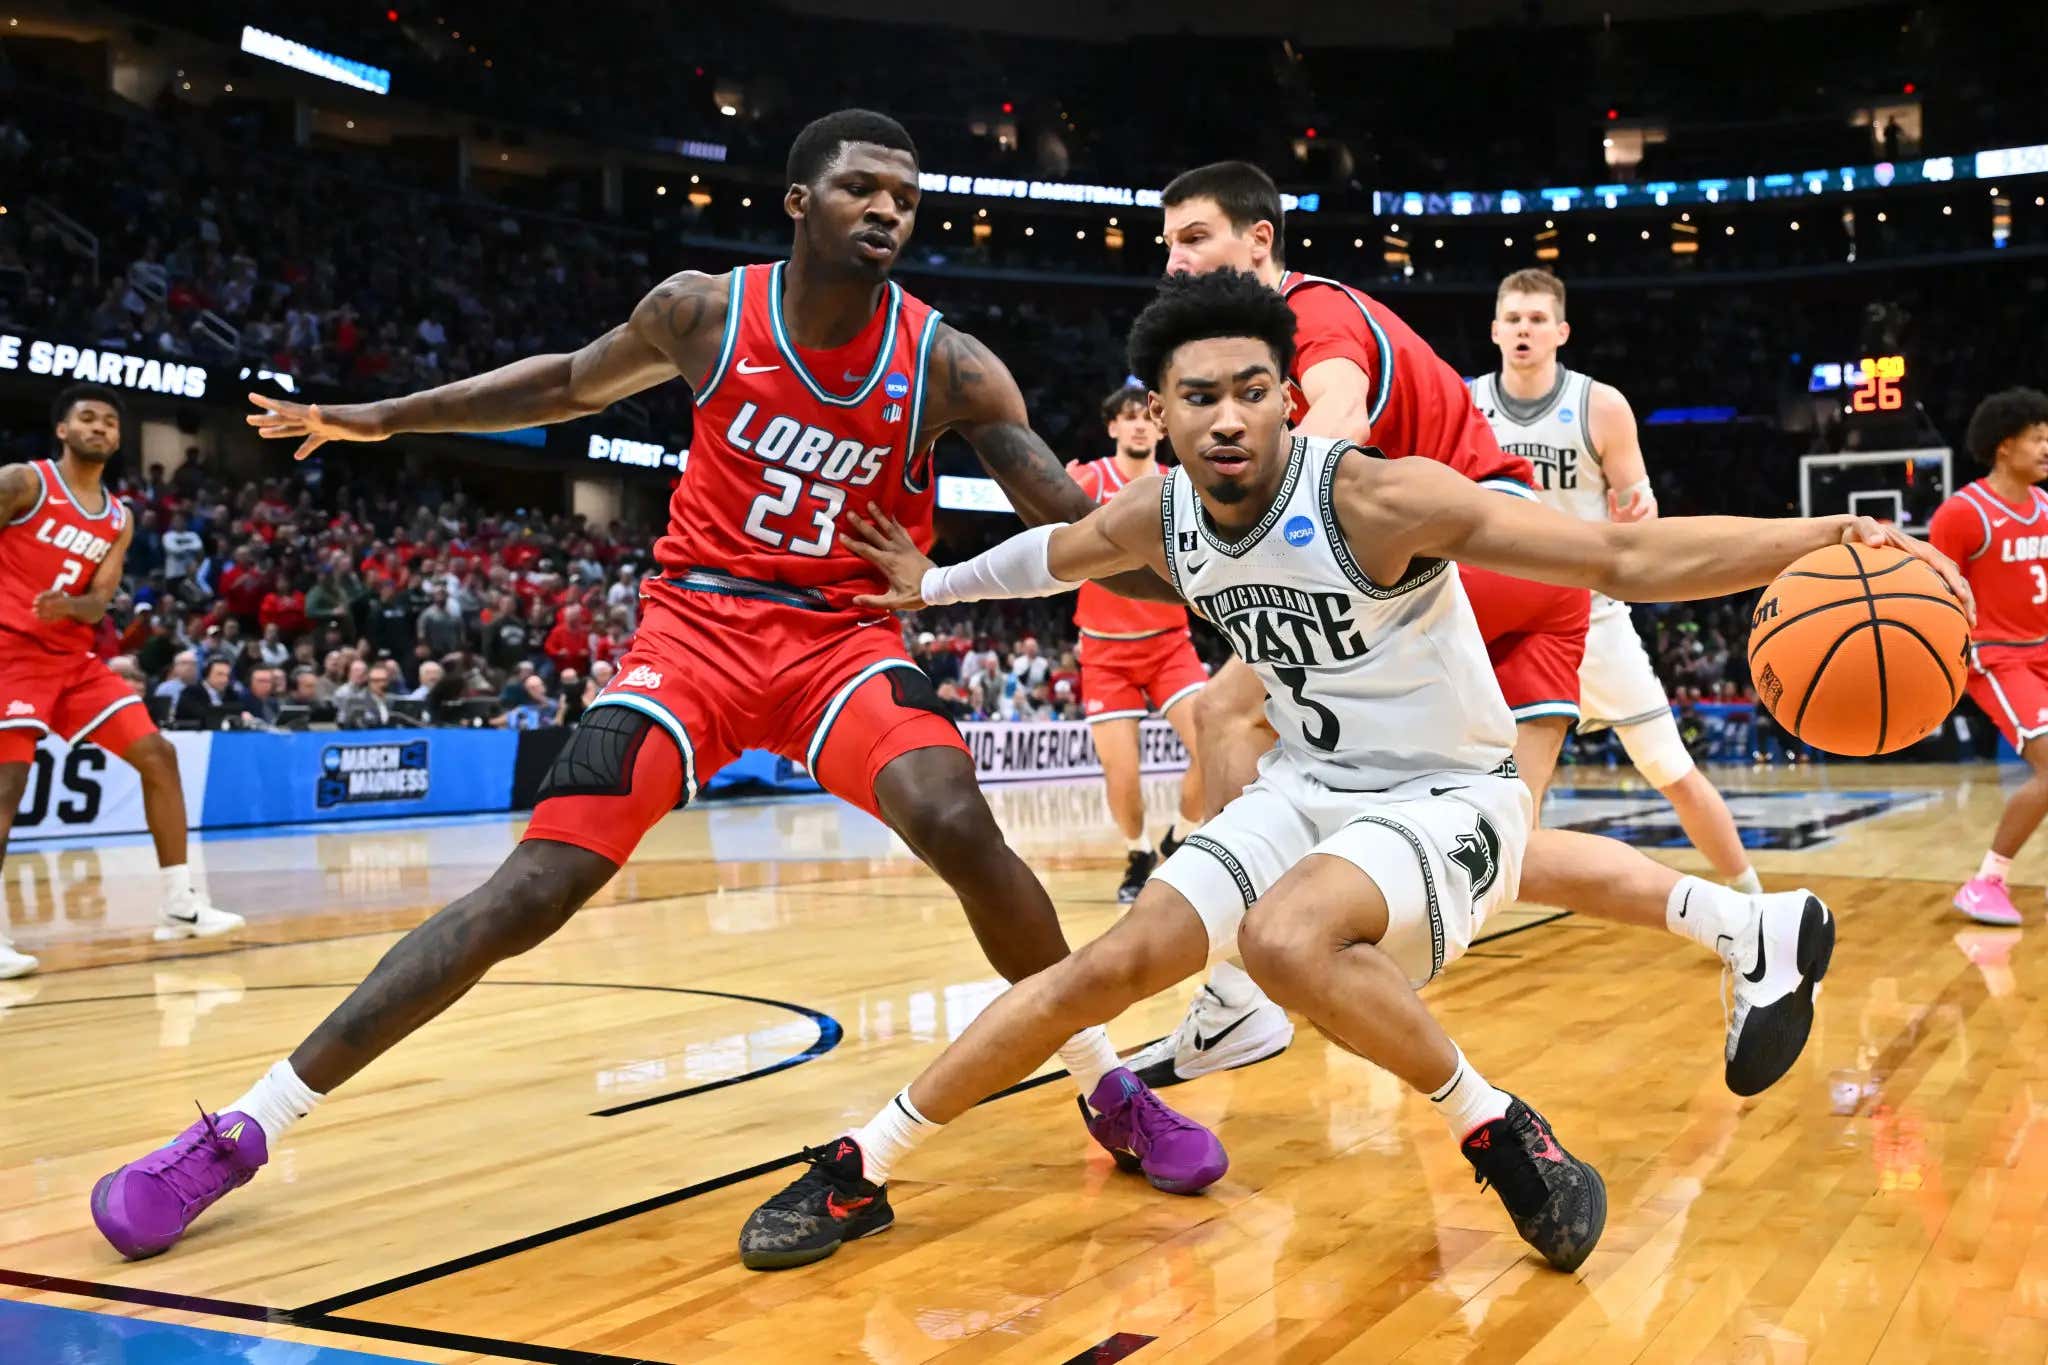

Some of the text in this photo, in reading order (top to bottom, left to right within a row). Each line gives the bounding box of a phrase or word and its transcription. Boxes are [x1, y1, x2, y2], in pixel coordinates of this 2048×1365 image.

[1028, 181, 1133, 205] BASKETBALL
[28, 340, 207, 398] SPARTANS
[1854, 377, 1902, 412] 26
[726, 400, 892, 486] LOBOS
[744, 467, 846, 557] 23
[1288, 526, 1314, 541] NCAA
[51, 559, 82, 598] 2
[2029, 565, 2047, 605] 3
[1218, 585, 1312, 614] MICHIGAN
[341, 747, 400, 772] MARCH
[349, 769, 429, 795] MADNESS
